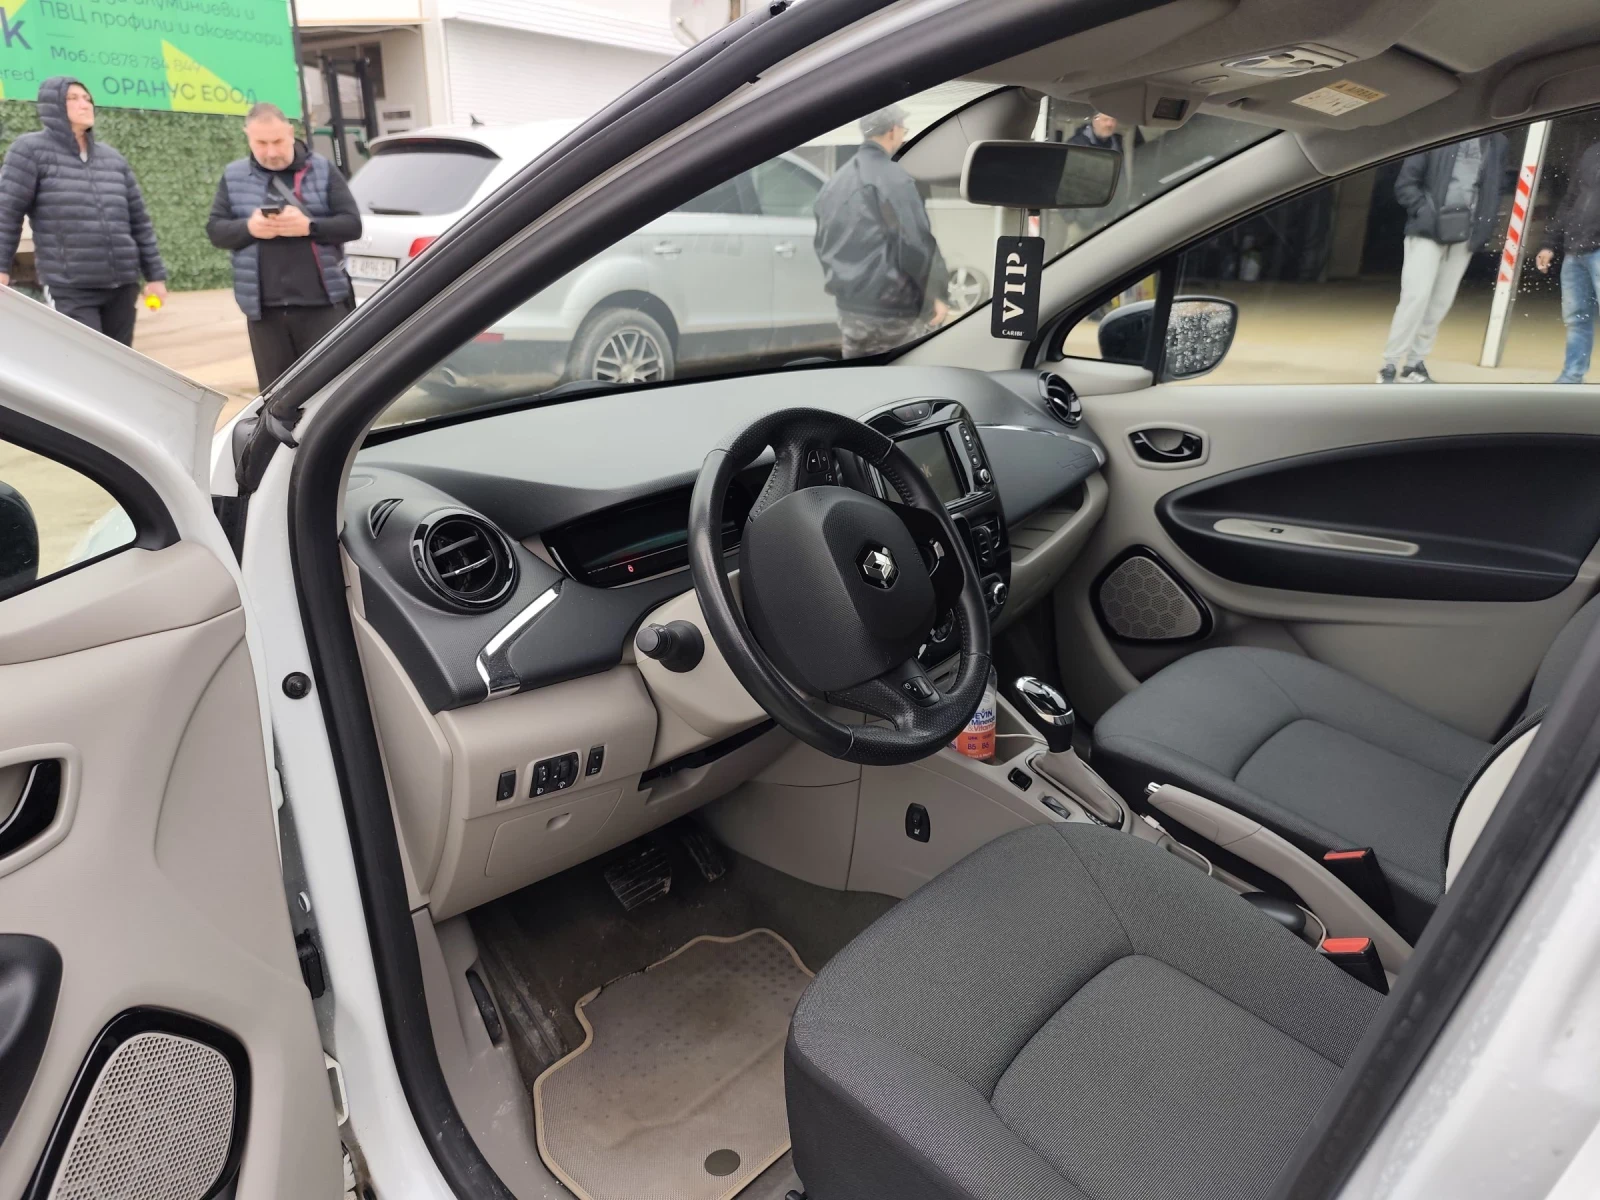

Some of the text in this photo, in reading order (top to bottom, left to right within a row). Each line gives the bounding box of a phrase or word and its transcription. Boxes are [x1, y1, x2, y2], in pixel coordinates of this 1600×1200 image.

[40, 0, 283, 48] ПВЦ профили и аксесоари
[0, 67, 40, 83] red.
[98, 51, 140, 69] 0878
[102, 75, 258, 105] ОРАНУС ЕООД
[1002, 252, 1028, 323] VIP
